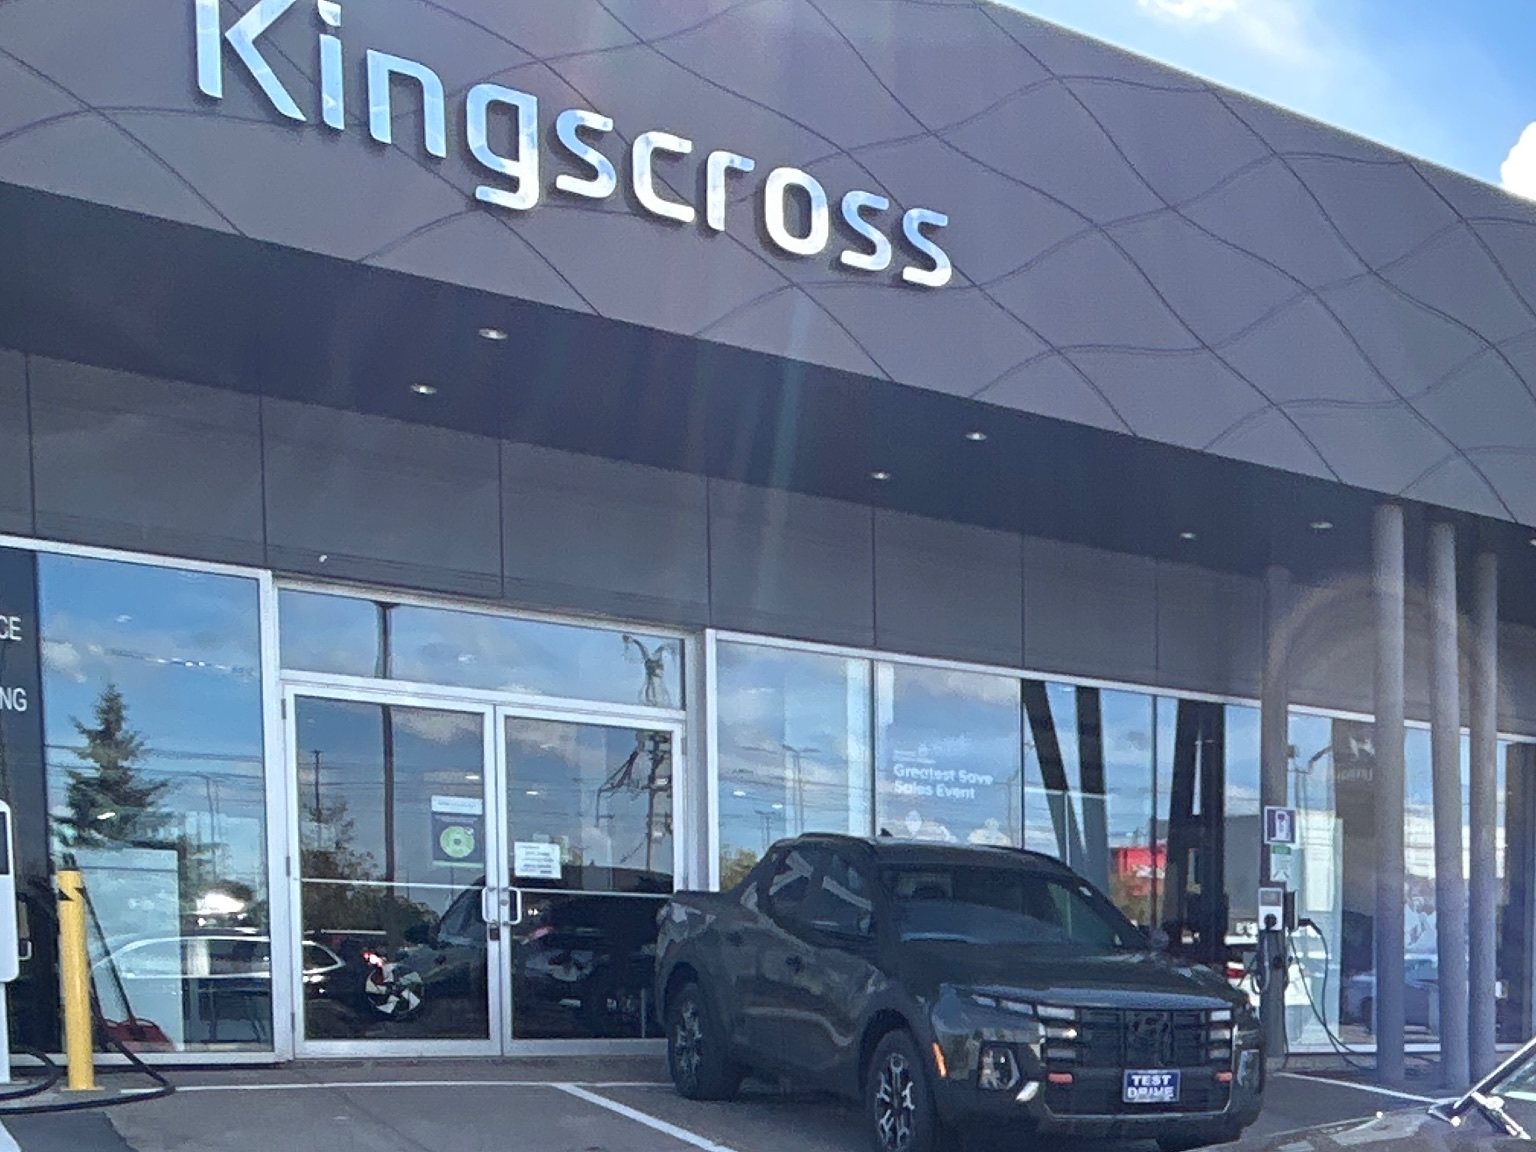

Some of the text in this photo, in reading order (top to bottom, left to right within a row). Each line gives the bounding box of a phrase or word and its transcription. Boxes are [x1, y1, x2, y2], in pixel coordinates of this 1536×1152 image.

[194, 0, 952, 288] Kingscross
[893, 764, 955, 782] Greatest
[894, 780, 975, 799] Sales Event
[1131, 1074, 1171, 1086] TEST
[1127, 1087, 1174, 1098] DRIVE
